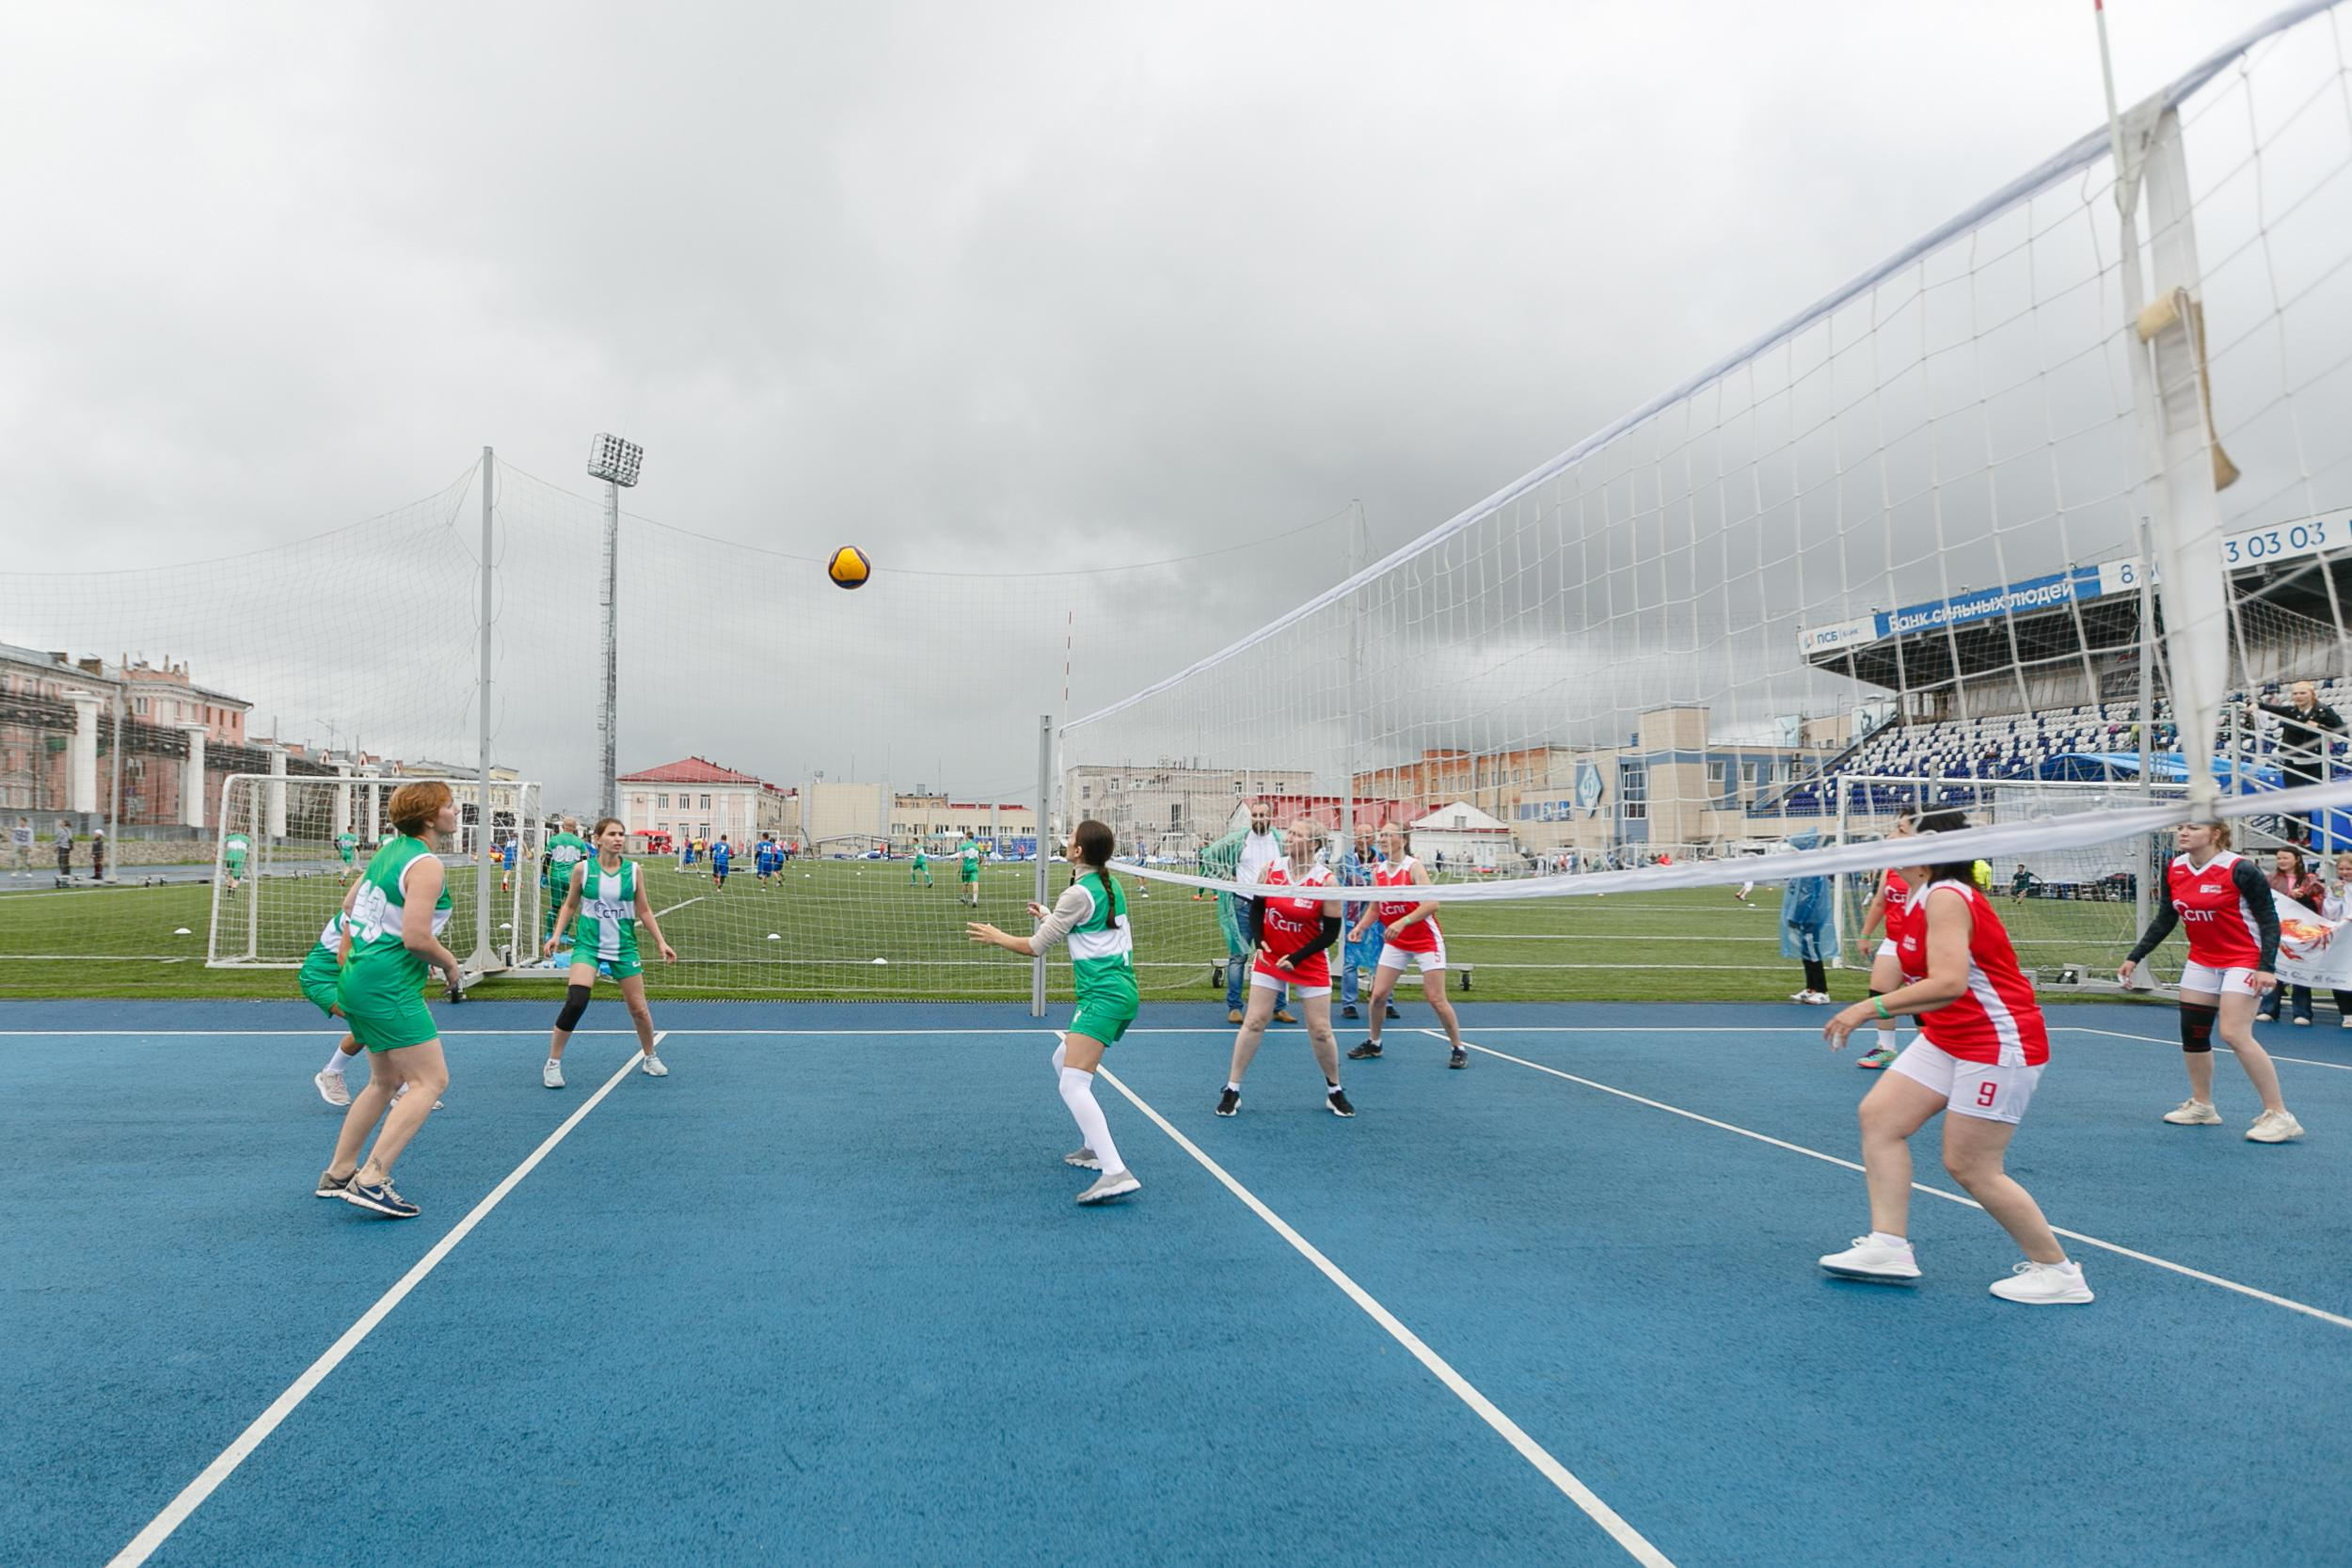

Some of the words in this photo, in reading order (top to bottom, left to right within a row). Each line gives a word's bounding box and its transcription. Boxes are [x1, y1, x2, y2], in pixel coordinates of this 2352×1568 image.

[2247, 531, 2281, 558] 03
[2290, 522, 2326, 549] 03
[1887, 613, 1929, 633] Банк
[1931, 598, 2006, 623] сильных
[2010, 578, 2075, 608] людей
[1817, 630, 1838, 644] ПСБ
[720, 845, 726, 854] 7
[1978, 1082, 1997, 1107] 9
